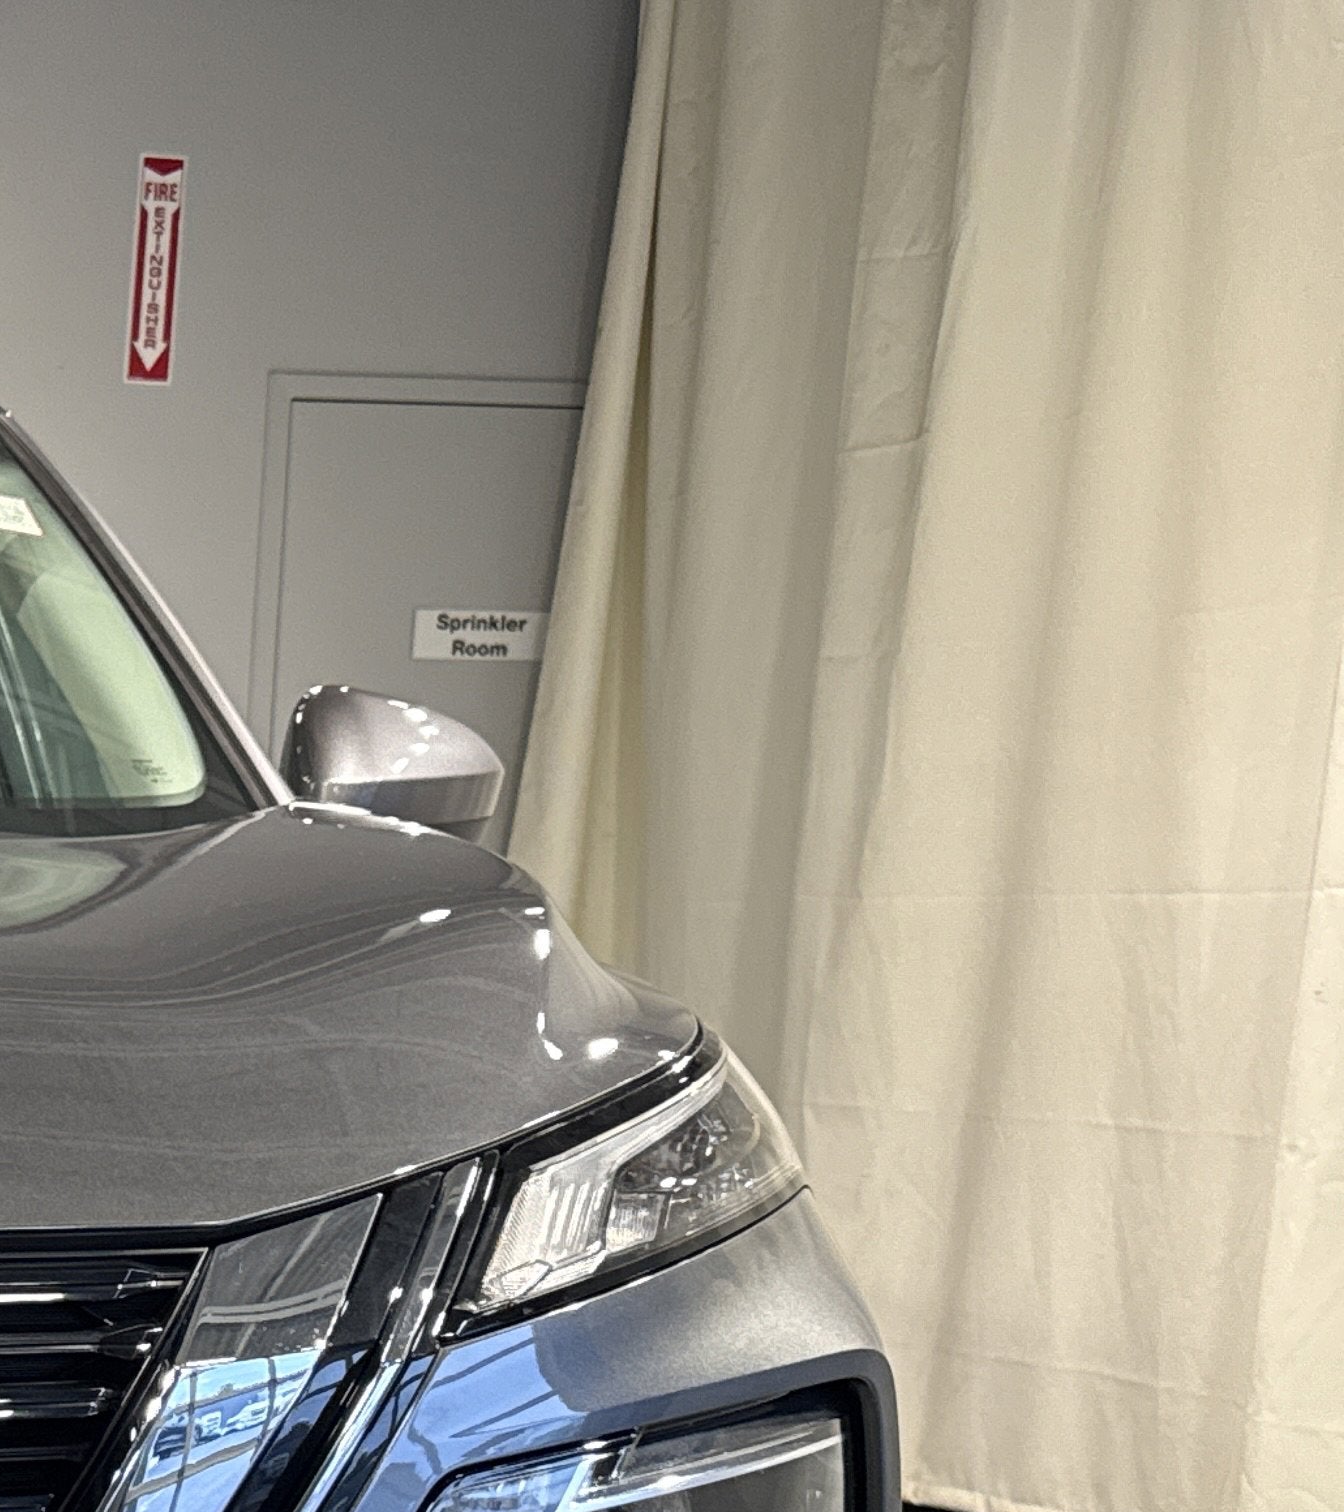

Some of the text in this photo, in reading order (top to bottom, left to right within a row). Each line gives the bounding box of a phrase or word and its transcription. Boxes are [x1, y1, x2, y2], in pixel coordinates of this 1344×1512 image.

[144, 182, 178, 202] FIRE
[144, 206, 166, 349] EXTINGUISHER
[436, 613, 527, 635] Sprinkler
[451, 639, 508, 657] Room
